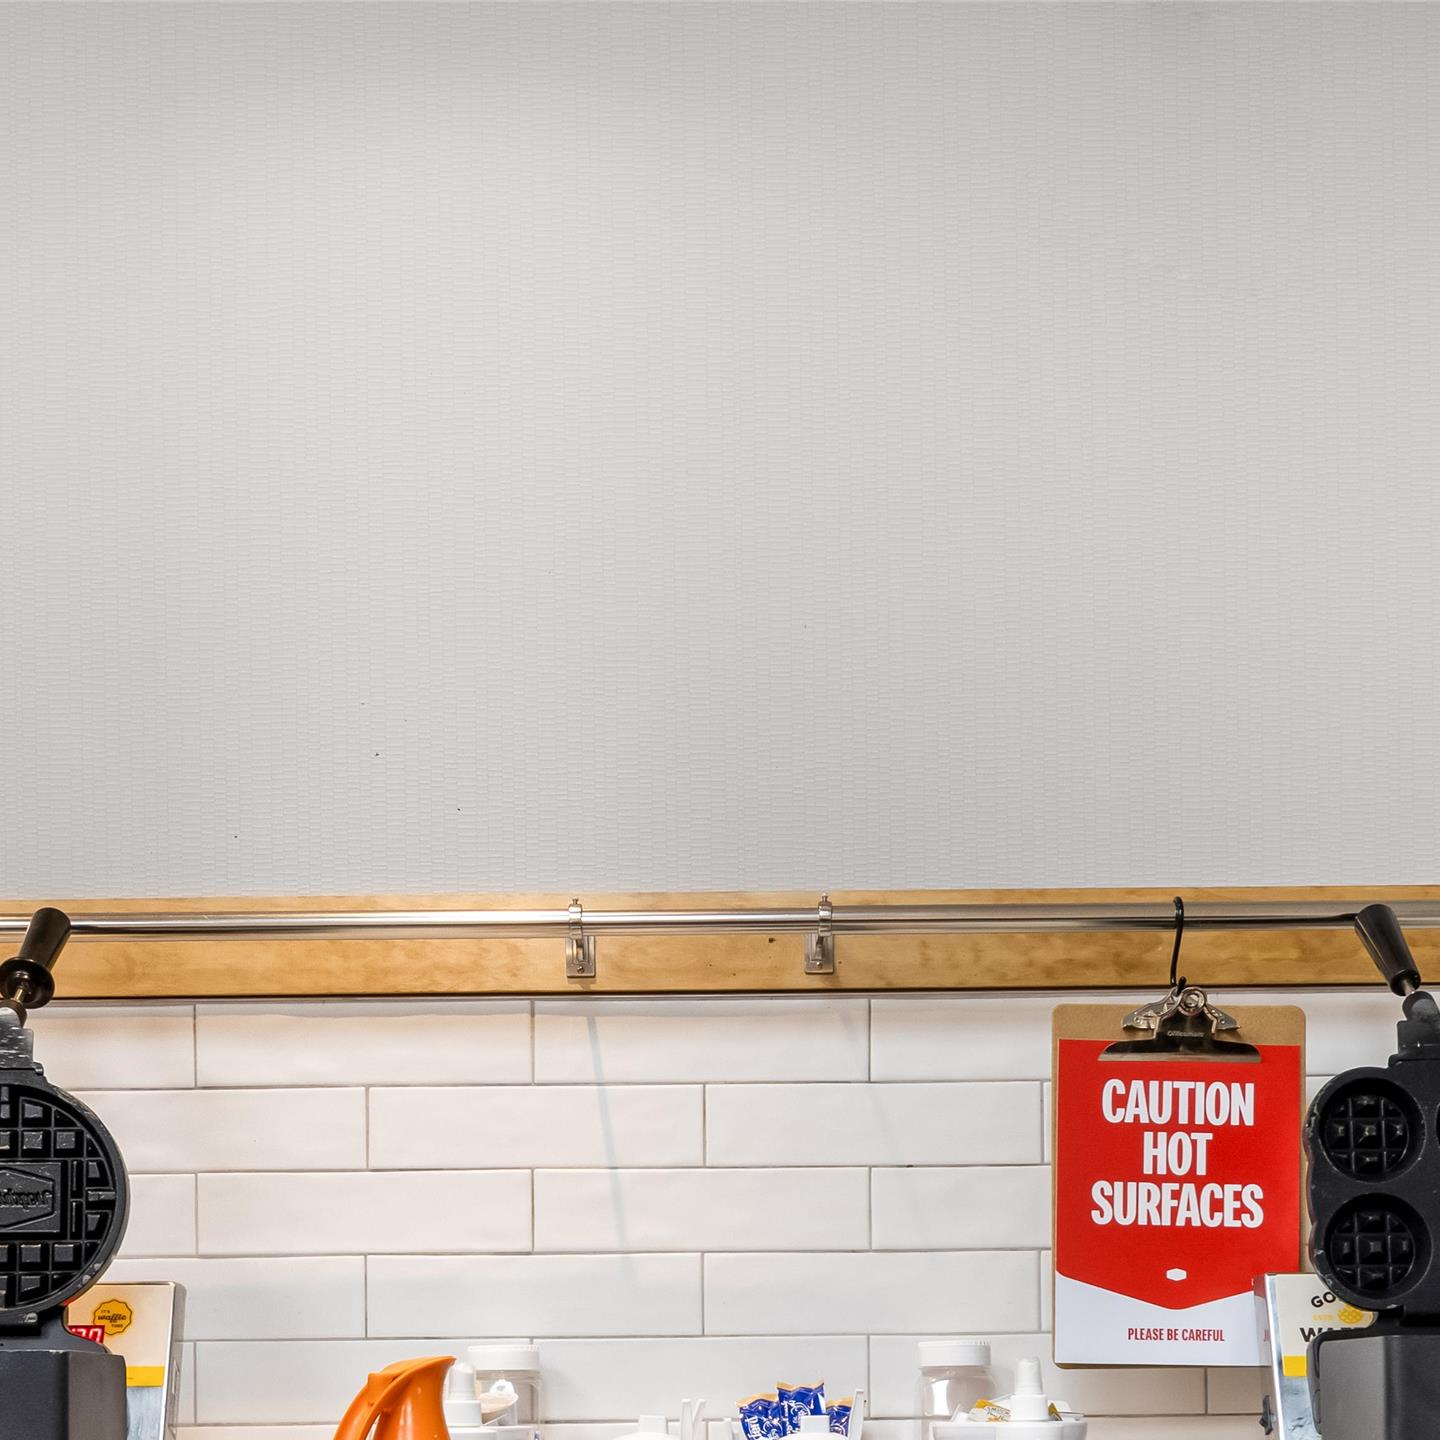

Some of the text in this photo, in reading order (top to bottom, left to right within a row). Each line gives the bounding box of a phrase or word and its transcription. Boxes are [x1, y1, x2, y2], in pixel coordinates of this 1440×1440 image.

[1102, 1078, 1254, 1126] CAUTION
[1143, 1131, 1213, 1176] HOT
[1091, 1180, 1264, 1228] SURFACES
[1128, 1328, 1225, 1342] PLEASE BE CAREFUL
